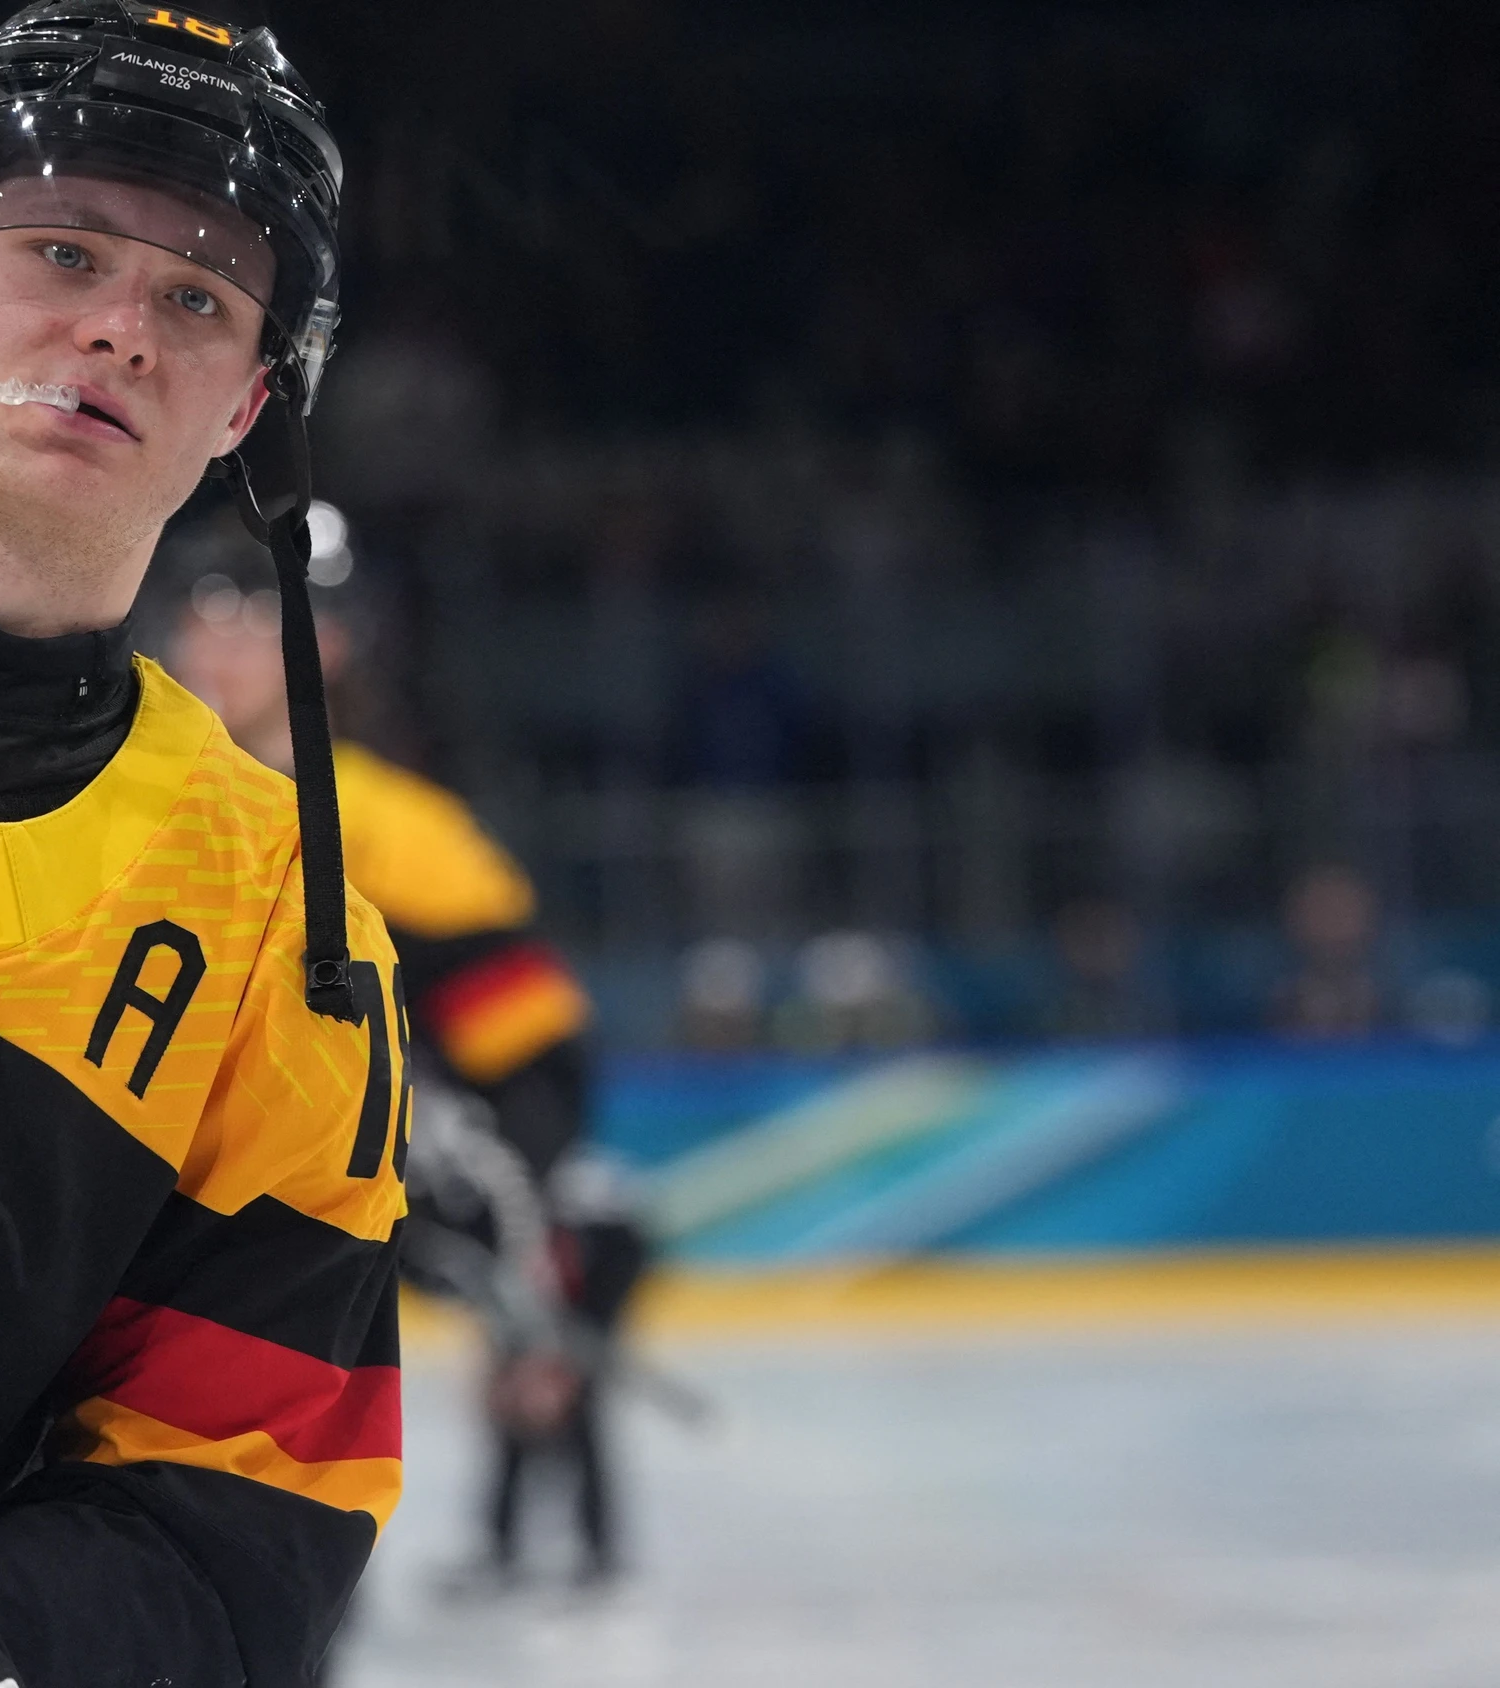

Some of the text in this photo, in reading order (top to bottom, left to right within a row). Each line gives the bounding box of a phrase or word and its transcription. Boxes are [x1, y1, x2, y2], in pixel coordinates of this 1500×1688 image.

[110, 52, 243, 96] MILANO CORTINA
[159, 73, 192, 91] 2026
[83, 918, 208, 1101] A
